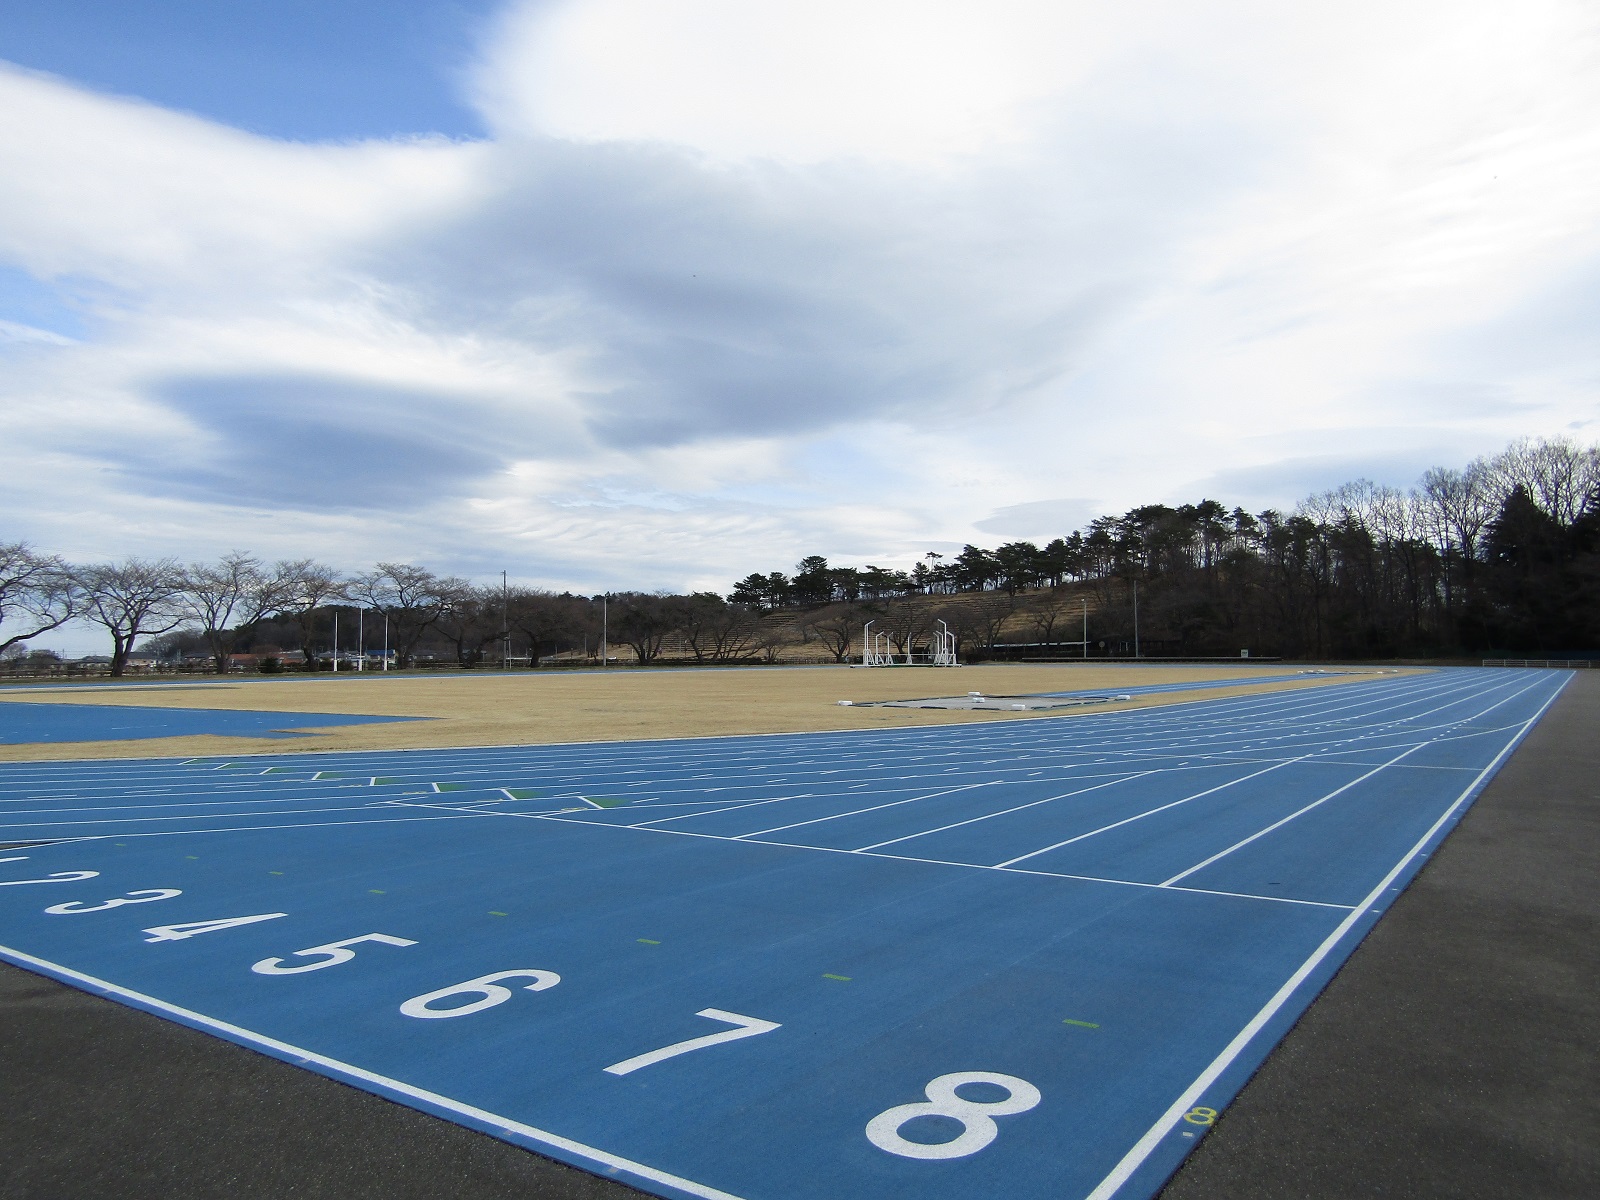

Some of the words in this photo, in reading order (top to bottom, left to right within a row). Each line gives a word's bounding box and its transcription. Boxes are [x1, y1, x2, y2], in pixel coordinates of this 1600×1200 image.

[44, 888, 183, 915] 3
[141, 912, 288, 943] 4
[251, 932, 419, 975] 5
[399, 969, 561, 1019] 6
[602, 1007, 782, 1076] 7
[865, 1071, 1042, 1160] 8
[1183, 1107, 1217, 1125] 8
